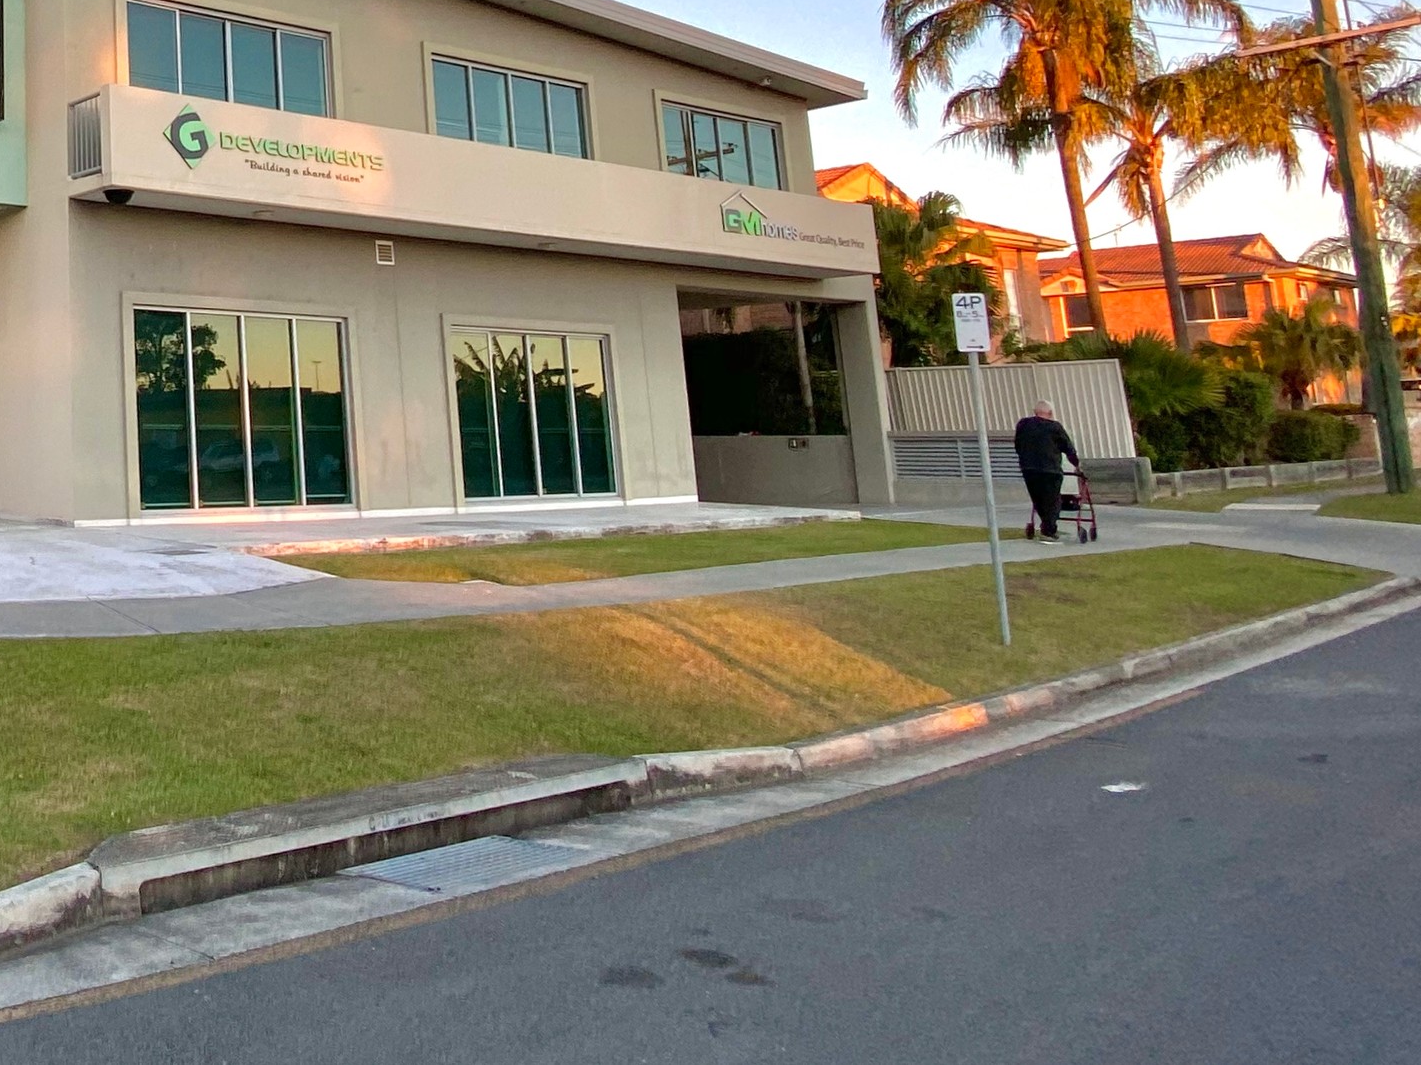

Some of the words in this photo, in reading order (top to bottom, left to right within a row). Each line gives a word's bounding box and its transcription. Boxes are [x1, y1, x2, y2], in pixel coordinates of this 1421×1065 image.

[219, 131, 384, 172] DEVELOPMENTS
[302, 167, 332, 179] shared
[762, 221, 799, 241] homes
[955, 295, 982, 310] 4P
